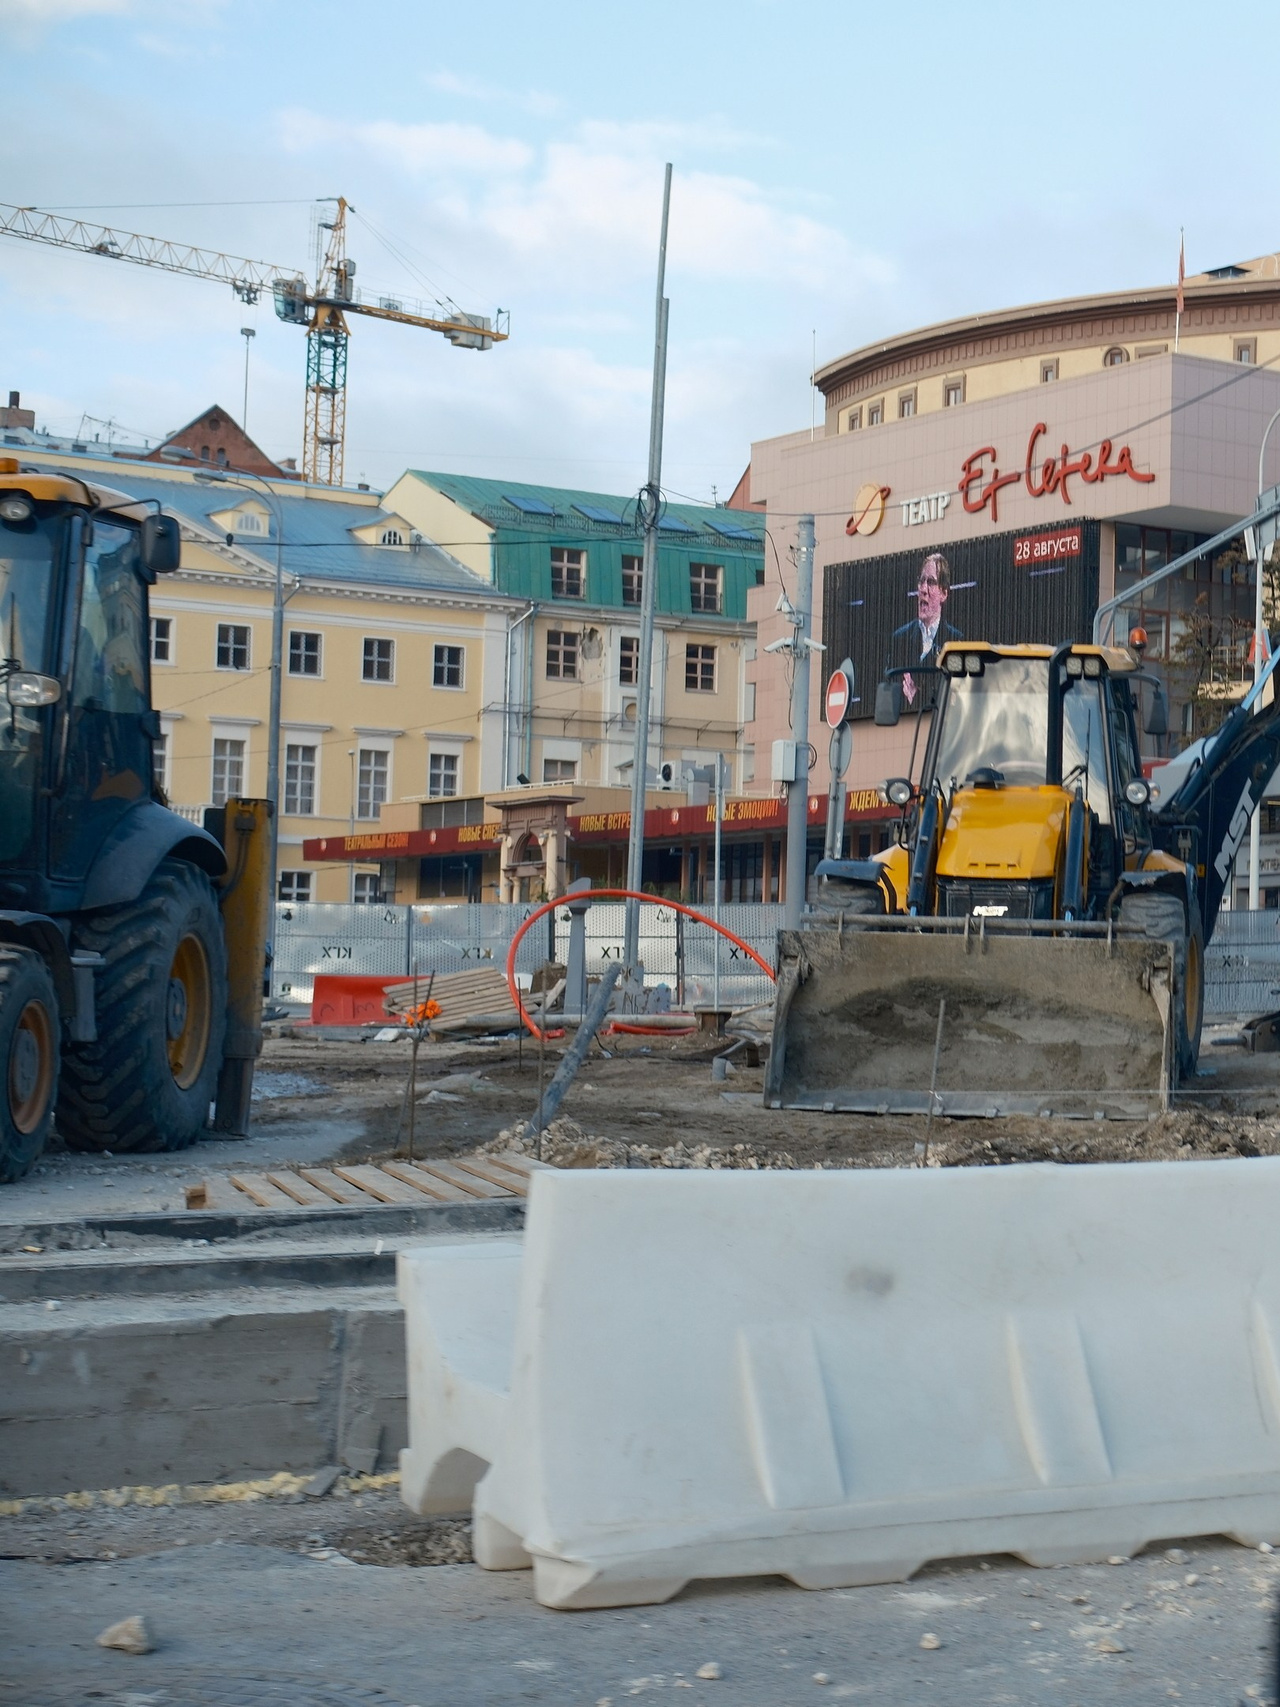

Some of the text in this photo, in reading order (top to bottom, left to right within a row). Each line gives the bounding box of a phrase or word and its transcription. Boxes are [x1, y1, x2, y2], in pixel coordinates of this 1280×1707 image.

[900, 491, 951, 527] ТЕАТР
[1016, 535, 1079, 560] 28 августа
[706, 799, 778, 822] НОЫЕ ЭМОЦИИ!
[849, 789, 879, 812] ЖДЕМ
[458, 826, 481, 842] НОВЫЕ
[580, 814, 606, 832] НОВЫЕ
[1214, 777, 1255, 883] MST
[344, 834, 386, 850] ТЕАТРАЛЬНЫЙ
